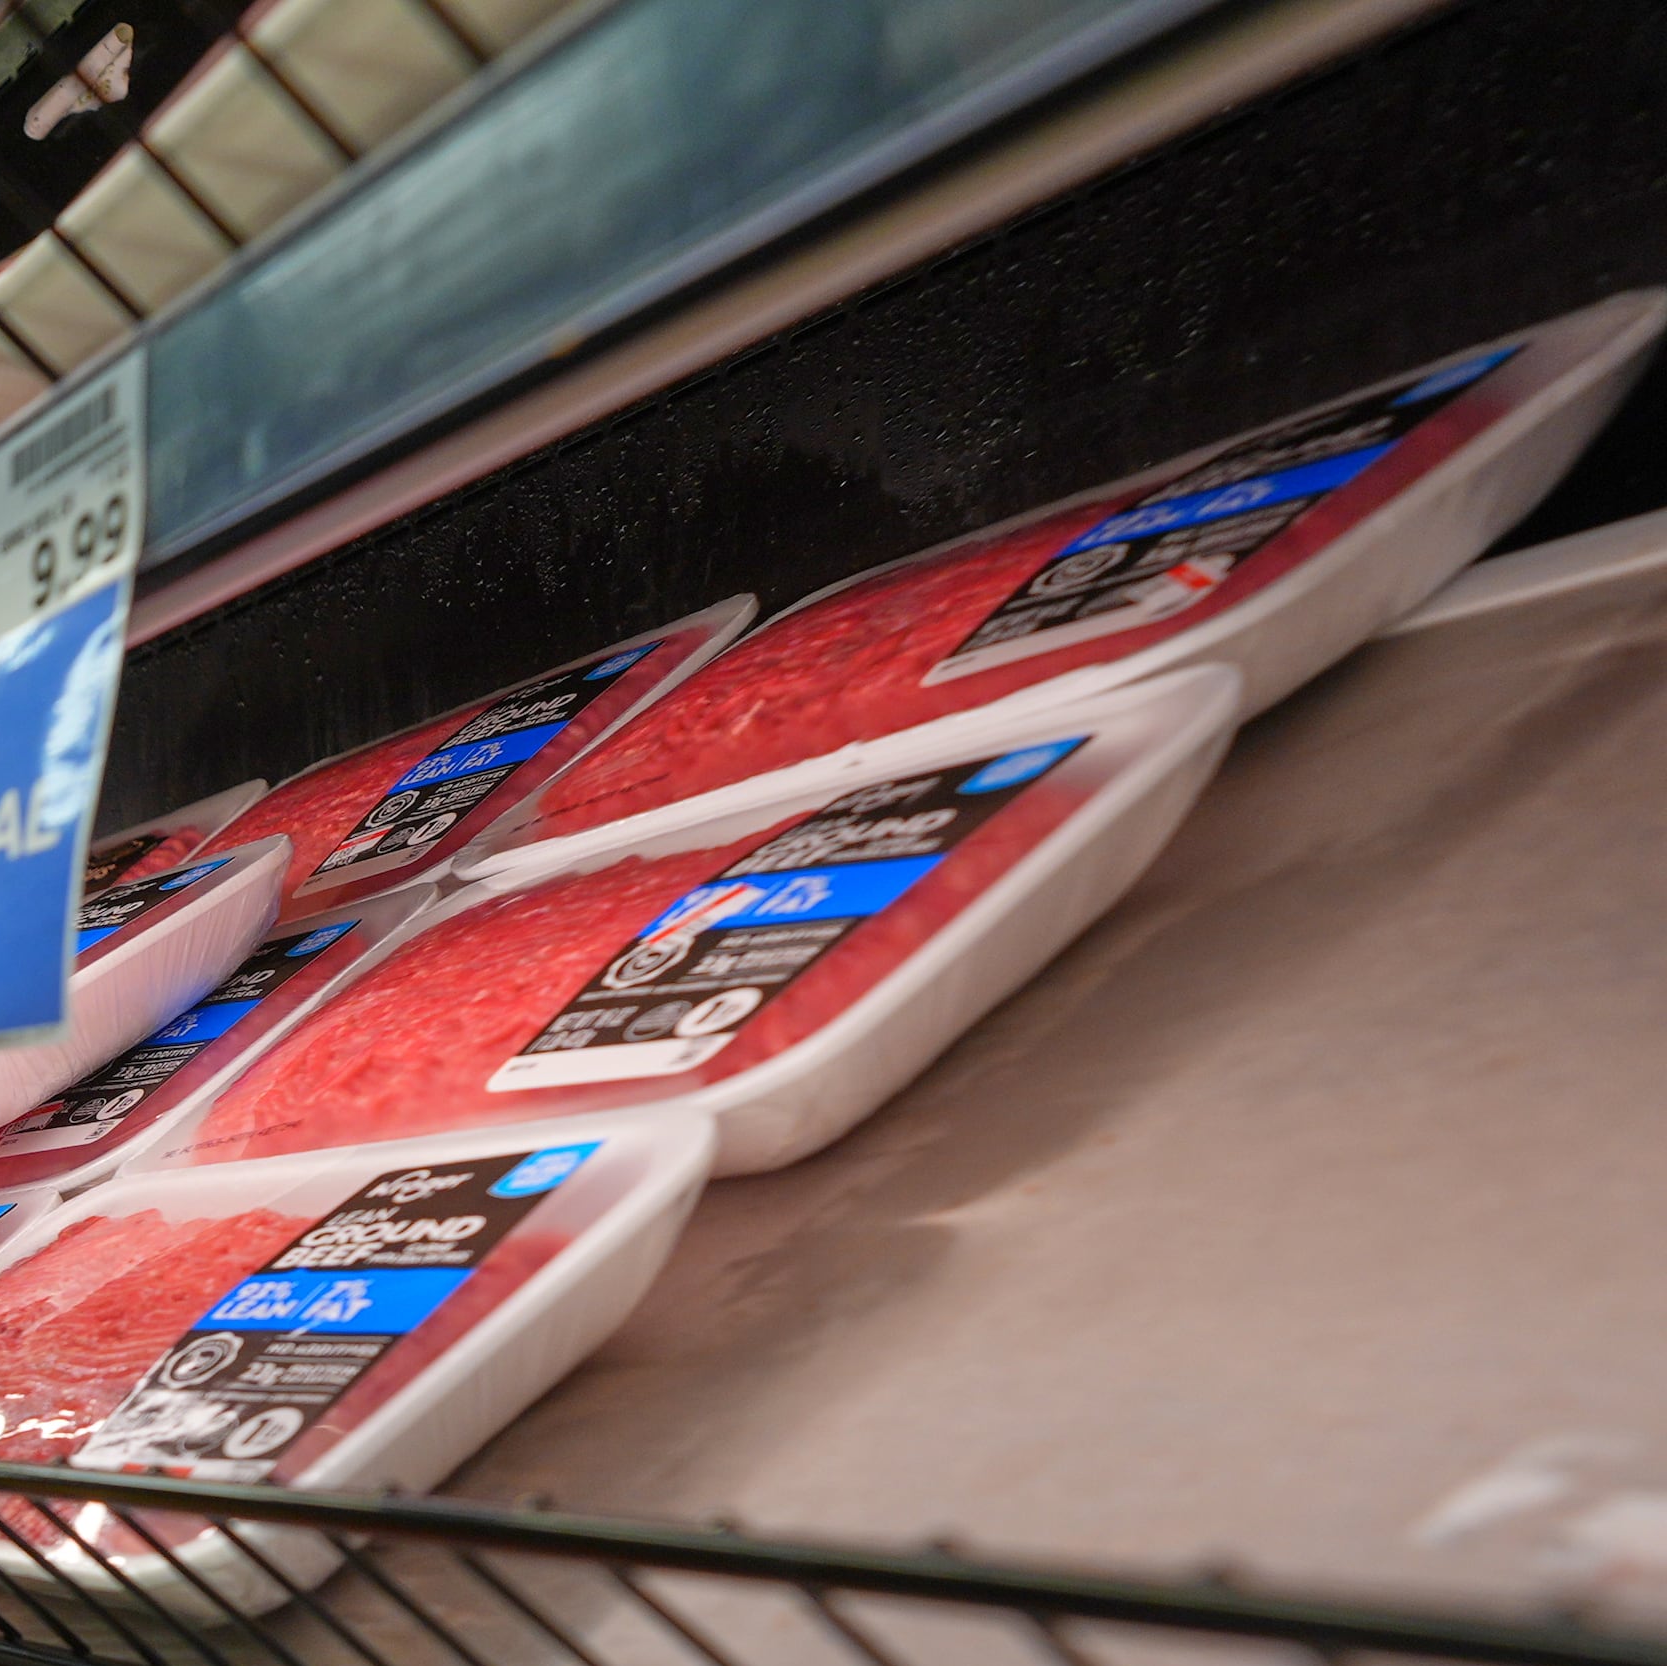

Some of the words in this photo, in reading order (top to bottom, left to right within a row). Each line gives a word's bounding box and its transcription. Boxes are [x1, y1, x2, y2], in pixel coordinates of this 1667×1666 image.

[33, 494, 128, 608] 9.99
[400, 765, 453, 786] LEAN
[459, 750, 503, 772] FAT
[299, 1214, 487, 1247] GROUND
[271, 1242, 385, 1271] BEEF
[211, 1299, 300, 1321] LEAN
[299, 1298, 373, 1322] FAT
